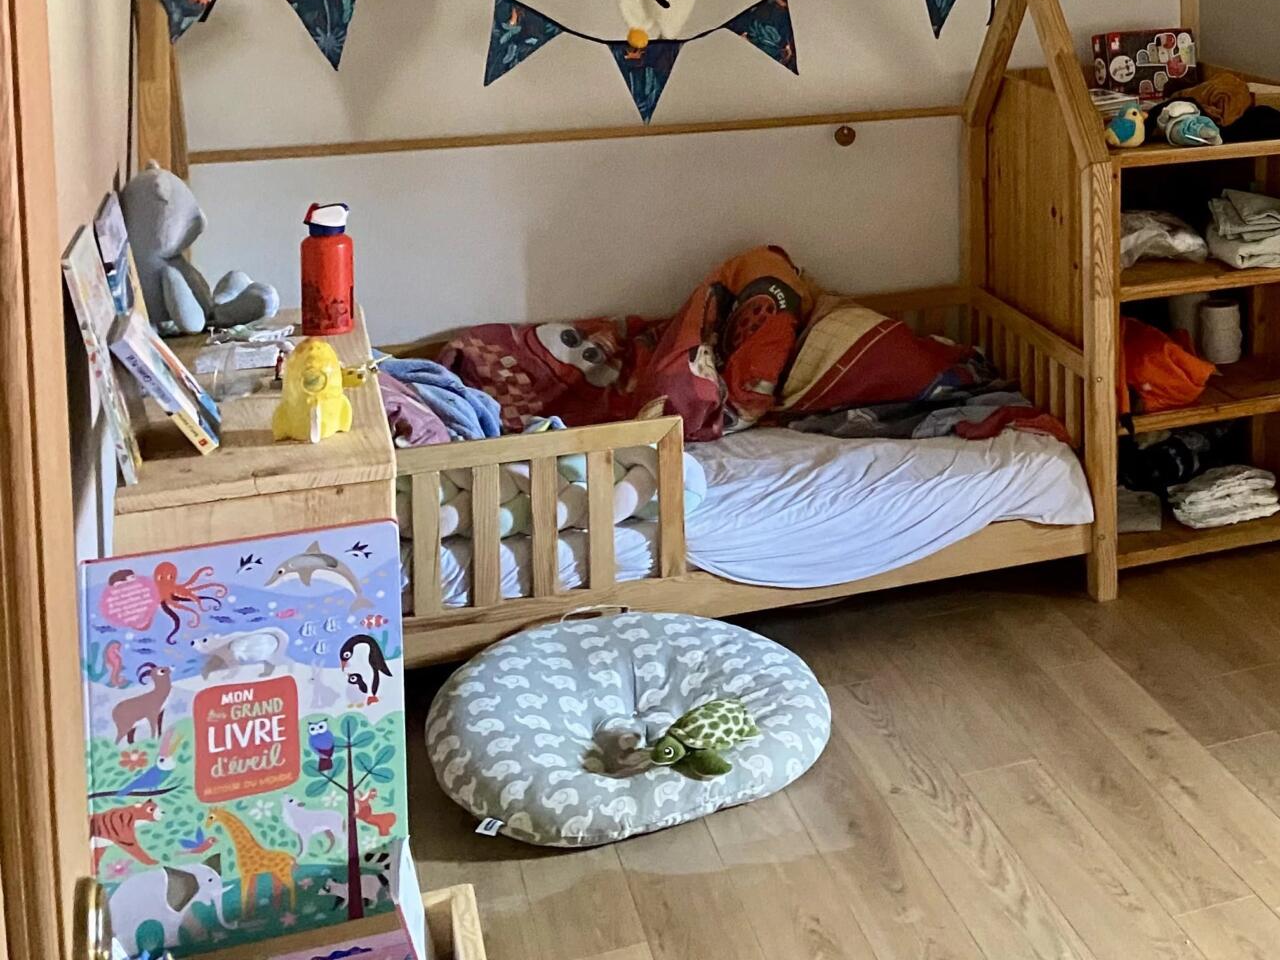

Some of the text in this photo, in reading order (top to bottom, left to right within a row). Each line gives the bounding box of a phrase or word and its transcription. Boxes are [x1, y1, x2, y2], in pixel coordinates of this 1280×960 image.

[221, 688, 254, 705] MON
[230, 697, 284, 720] GRAND
[208, 714, 287, 753] LIVRE
[210, 743, 286, 778] d'éveil
